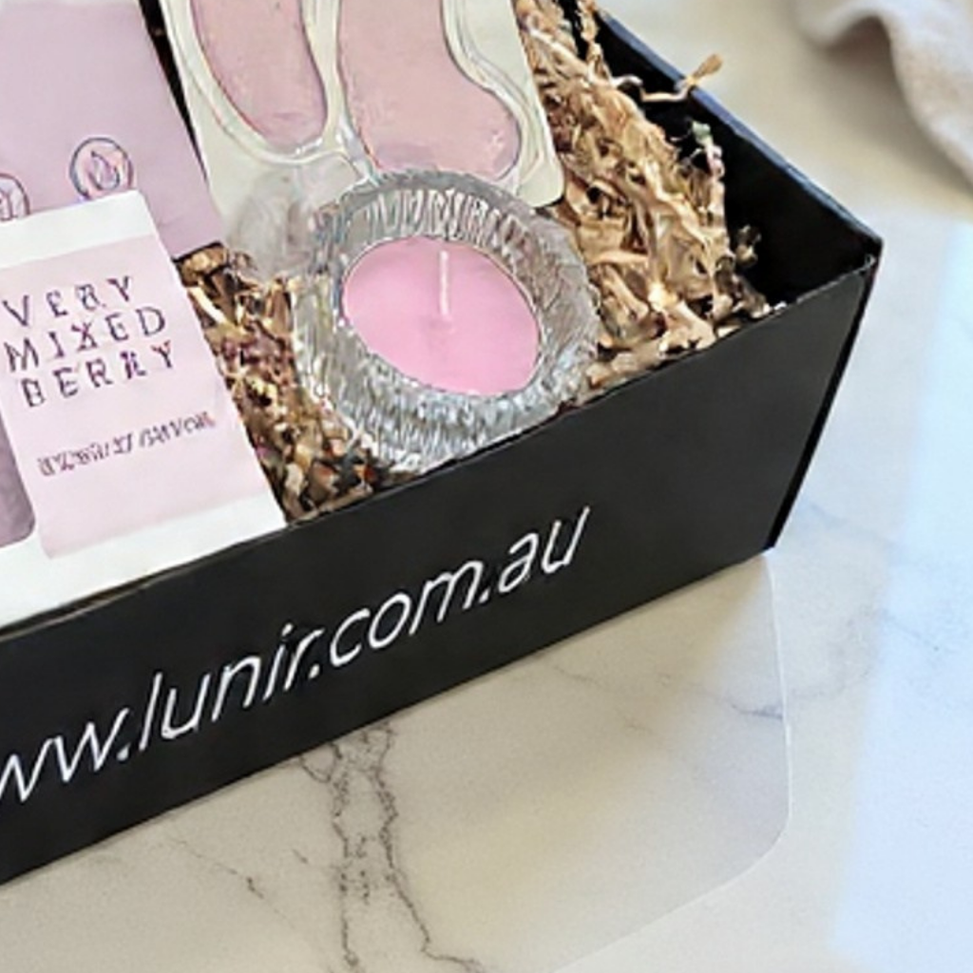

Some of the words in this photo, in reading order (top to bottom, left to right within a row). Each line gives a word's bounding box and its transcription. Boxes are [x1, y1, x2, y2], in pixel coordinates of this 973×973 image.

[2, 275, 134, 327] VERY
[4, 306, 167, 373] MIXED
[21, 340, 174, 408] BERRY
